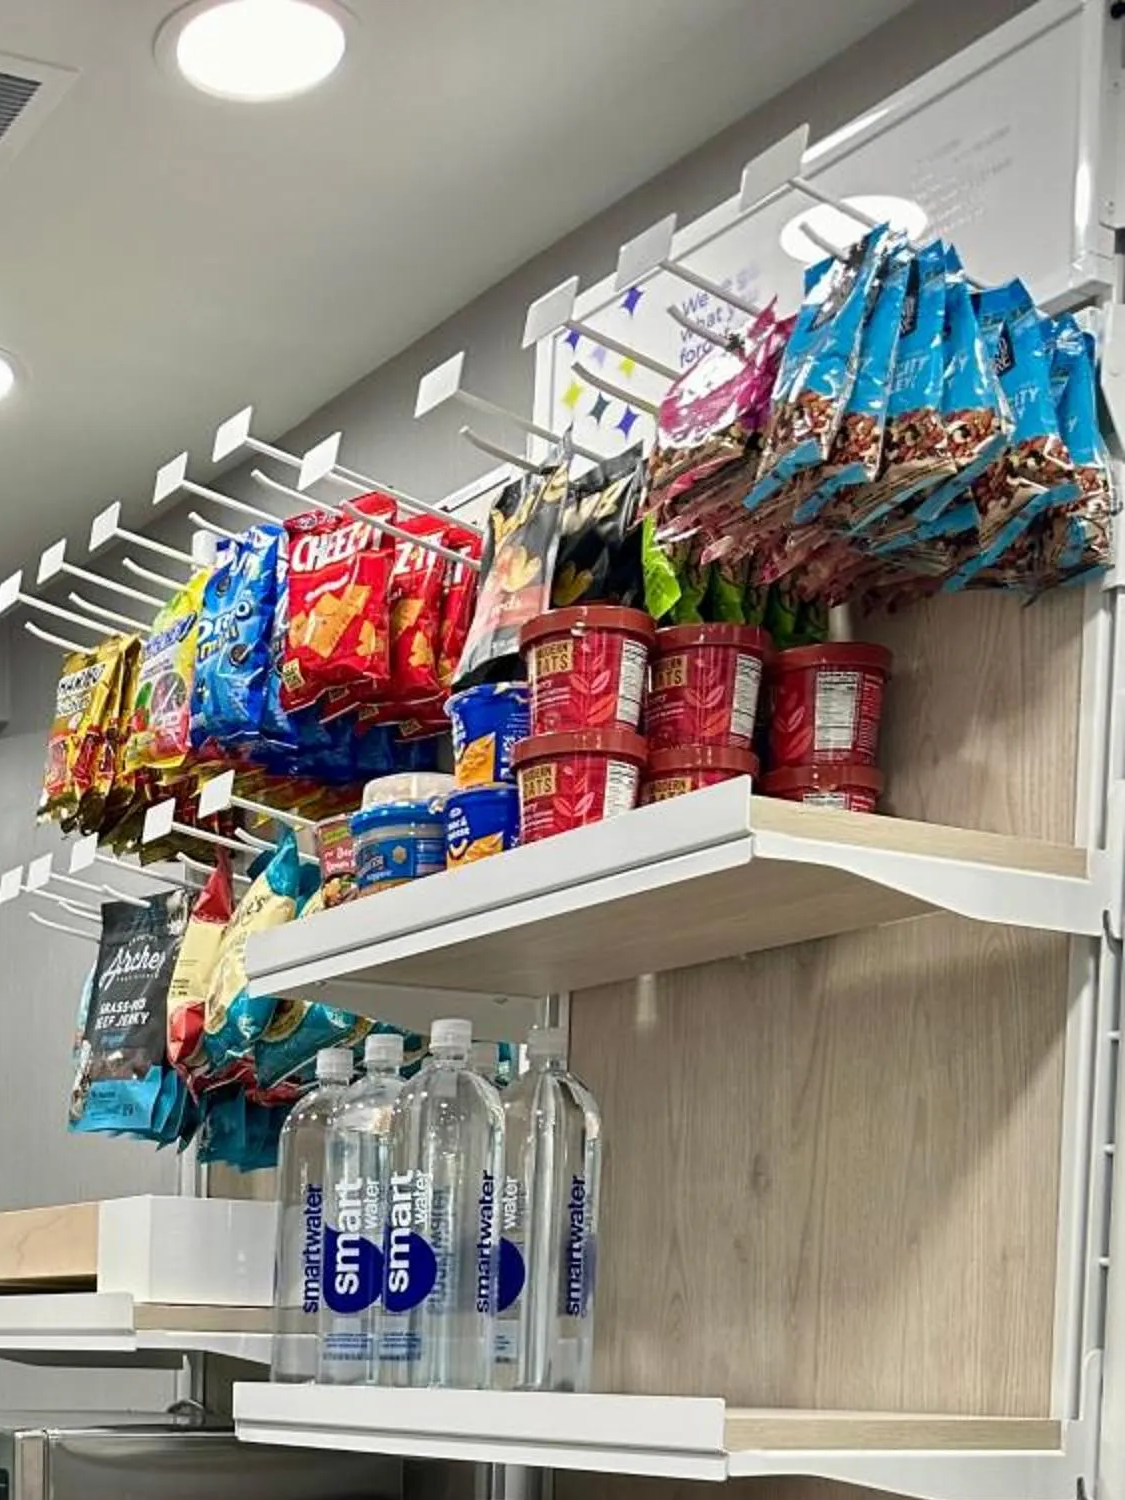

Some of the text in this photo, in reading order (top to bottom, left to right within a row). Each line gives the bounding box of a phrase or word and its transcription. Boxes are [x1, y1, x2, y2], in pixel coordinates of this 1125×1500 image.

[303, 1184, 323, 1313] smartwater
[335, 1177, 363, 1295] smart
[364, 1177, 380, 1230] water
[388, 1170, 413, 1293] smart
[415, 1170, 432, 1226] water
[477, 1170, 496, 1313] smartwater
[503, 1176, 519, 1231] water
[566, 1175, 586, 1317] smartwater
